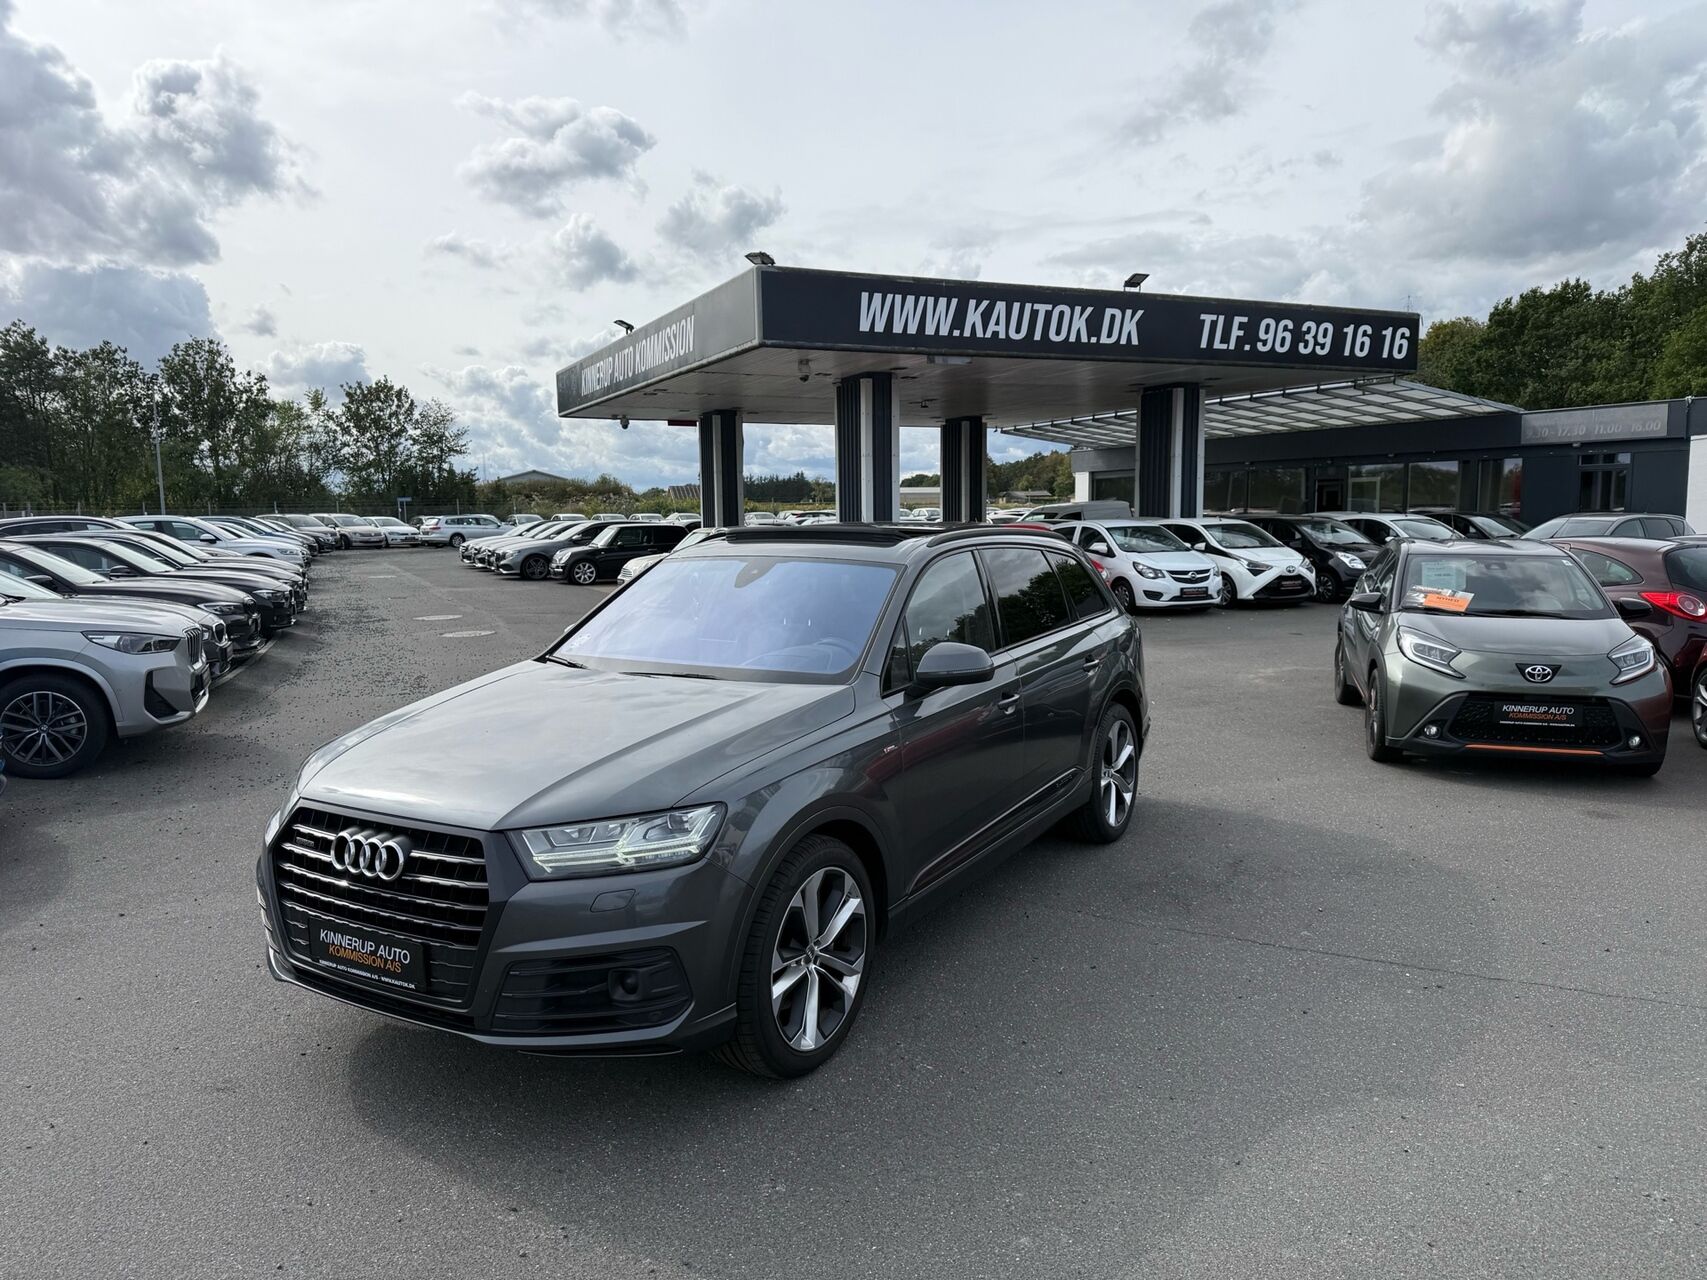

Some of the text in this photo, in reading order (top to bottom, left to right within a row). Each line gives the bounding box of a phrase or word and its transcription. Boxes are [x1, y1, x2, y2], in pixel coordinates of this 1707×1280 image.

[859, 291, 1144, 347] WWW.KAUTOK.DK
[1198, 313, 1410, 360] TLF. 96 39 16 16
[581, 315, 695, 397] KINNERUP AUTO KOMMISSION
[1502, 704, 1575, 715] KINNERUP AUTO
[1508, 712, 1553, 720] KOMMISSION
[319, 928, 410, 965] KINNERUP AUTO
[328, 944, 402, 973] KOMMISSION A/S
